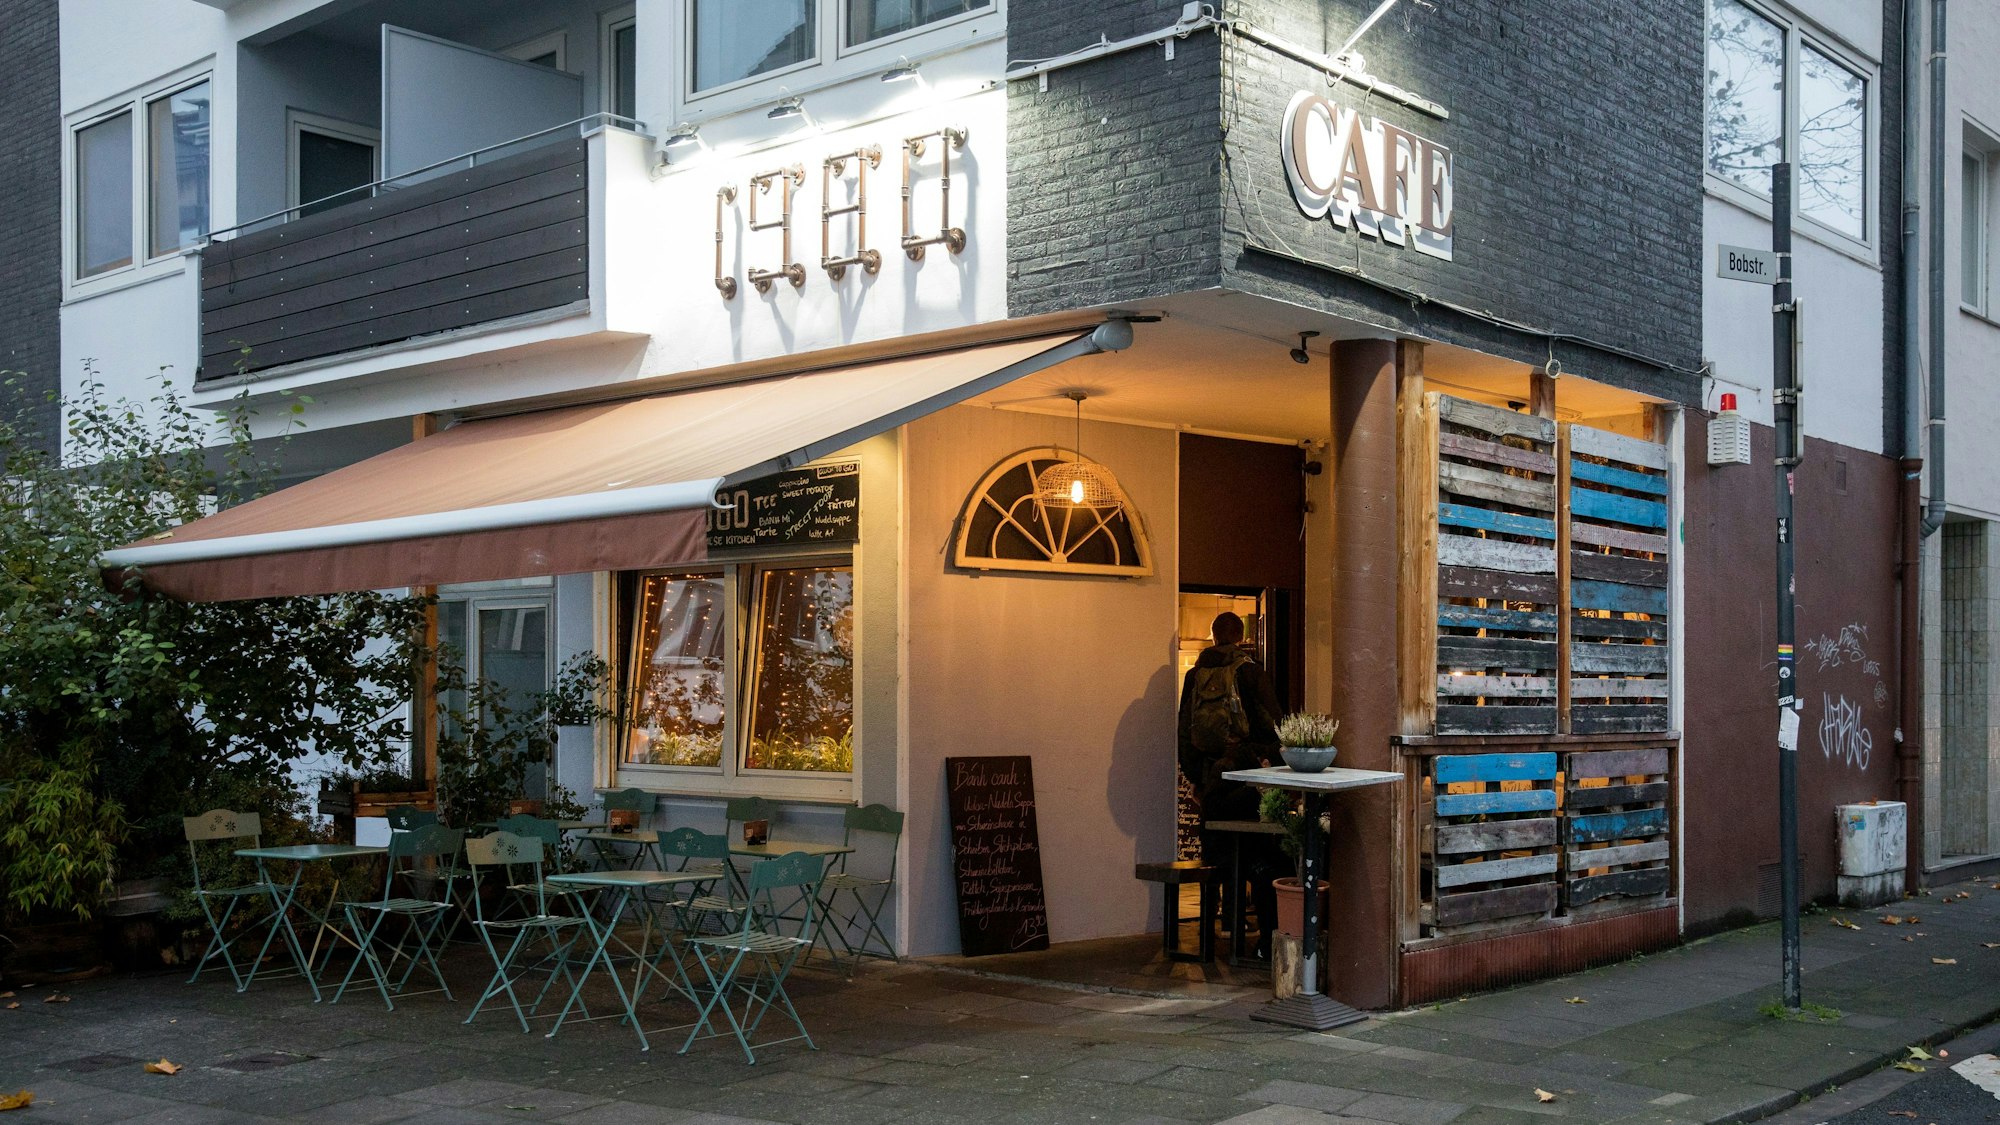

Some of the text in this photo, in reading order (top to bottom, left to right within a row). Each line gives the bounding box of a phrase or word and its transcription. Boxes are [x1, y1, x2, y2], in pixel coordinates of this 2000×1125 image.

[1286, 92, 1452, 242] CAFE
[714, 124, 969, 300] 1980
[1729, 252, 1767, 276] Bobstr.
[843, 464, 854, 472] GO
[782, 488, 804, 499] SWEET
[753, 527, 778, 537] Tarte
[785, 509, 812, 540] STREET
[725, 535, 756, 545] KITCHEN
